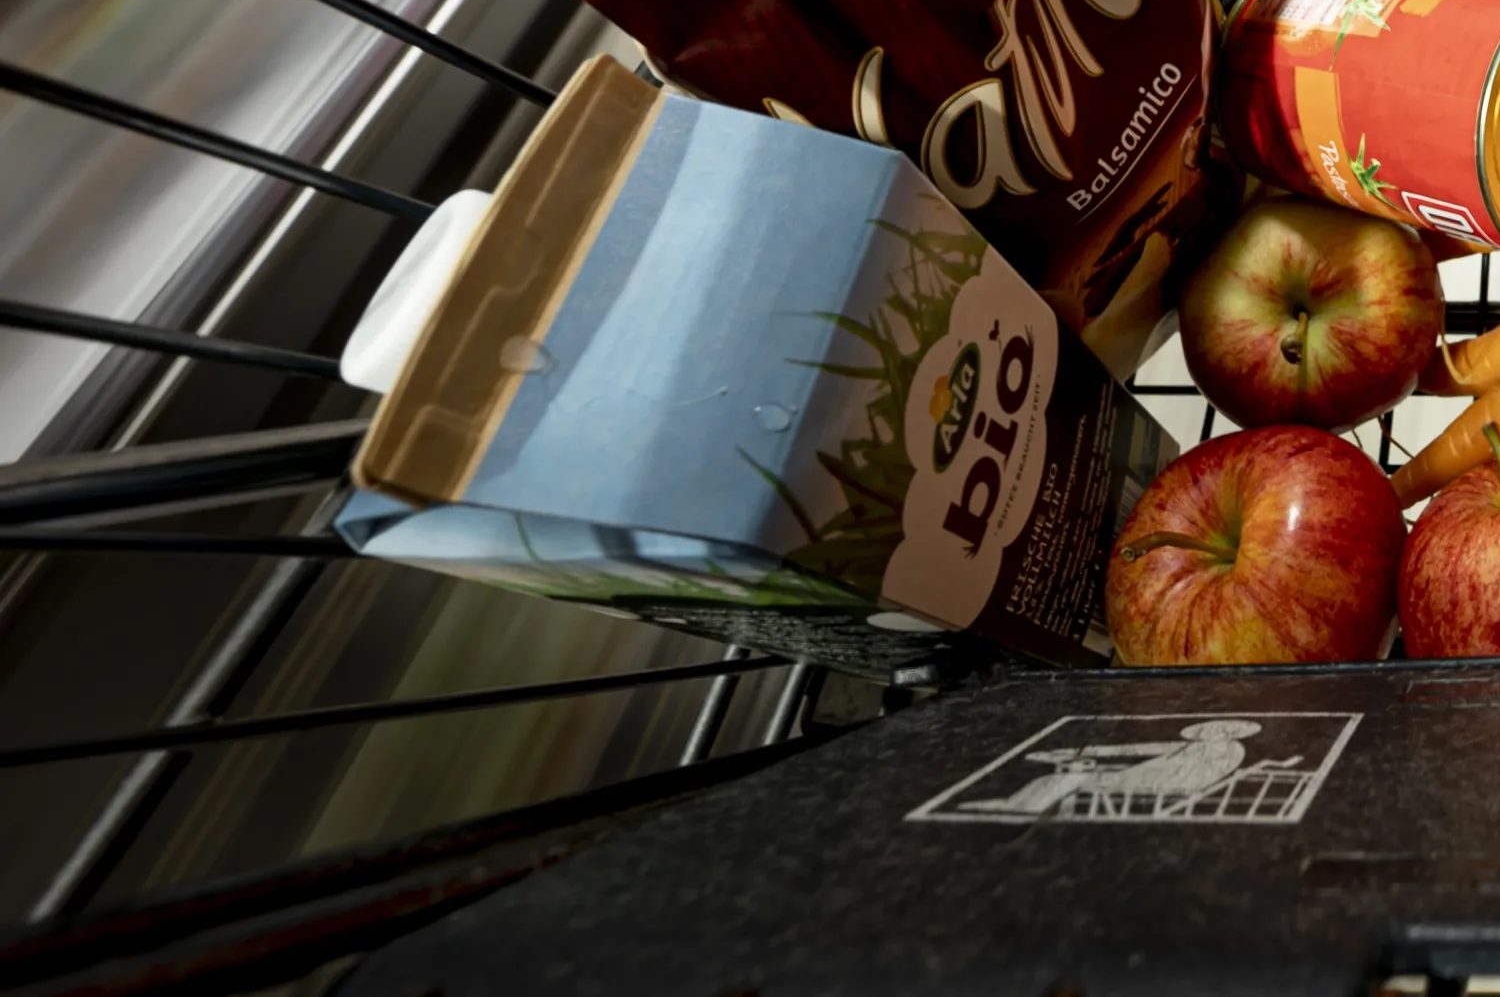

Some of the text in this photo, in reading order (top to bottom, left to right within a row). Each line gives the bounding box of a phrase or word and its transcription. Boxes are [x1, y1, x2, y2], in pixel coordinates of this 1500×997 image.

[1066, 61, 1182, 212] Balsamico
[940, 362, 976, 455] Arla
[942, 331, 1035, 555] bio
[1005, 512, 1047, 613] FRISCHE
[1016, 489, 1062, 615] VOLLMILCH
